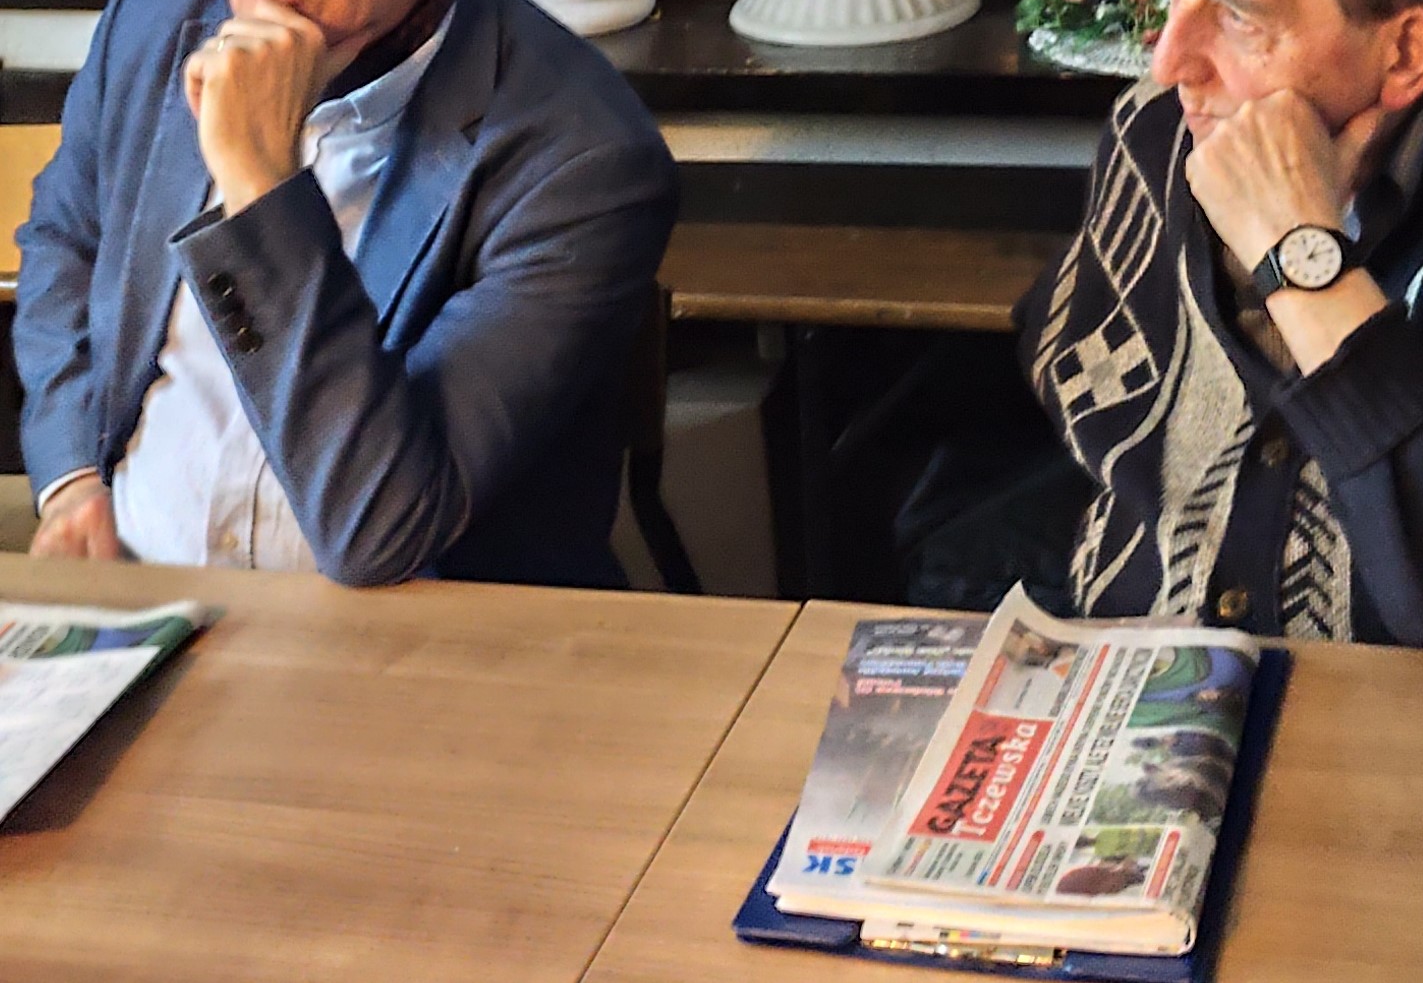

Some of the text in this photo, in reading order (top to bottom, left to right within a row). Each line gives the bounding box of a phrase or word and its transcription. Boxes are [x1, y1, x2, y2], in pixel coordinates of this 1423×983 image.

[928, 732, 1006, 834] GAZETA
[952, 722, 1037, 837] Tczewska
[803, 855, 857, 875] SK
